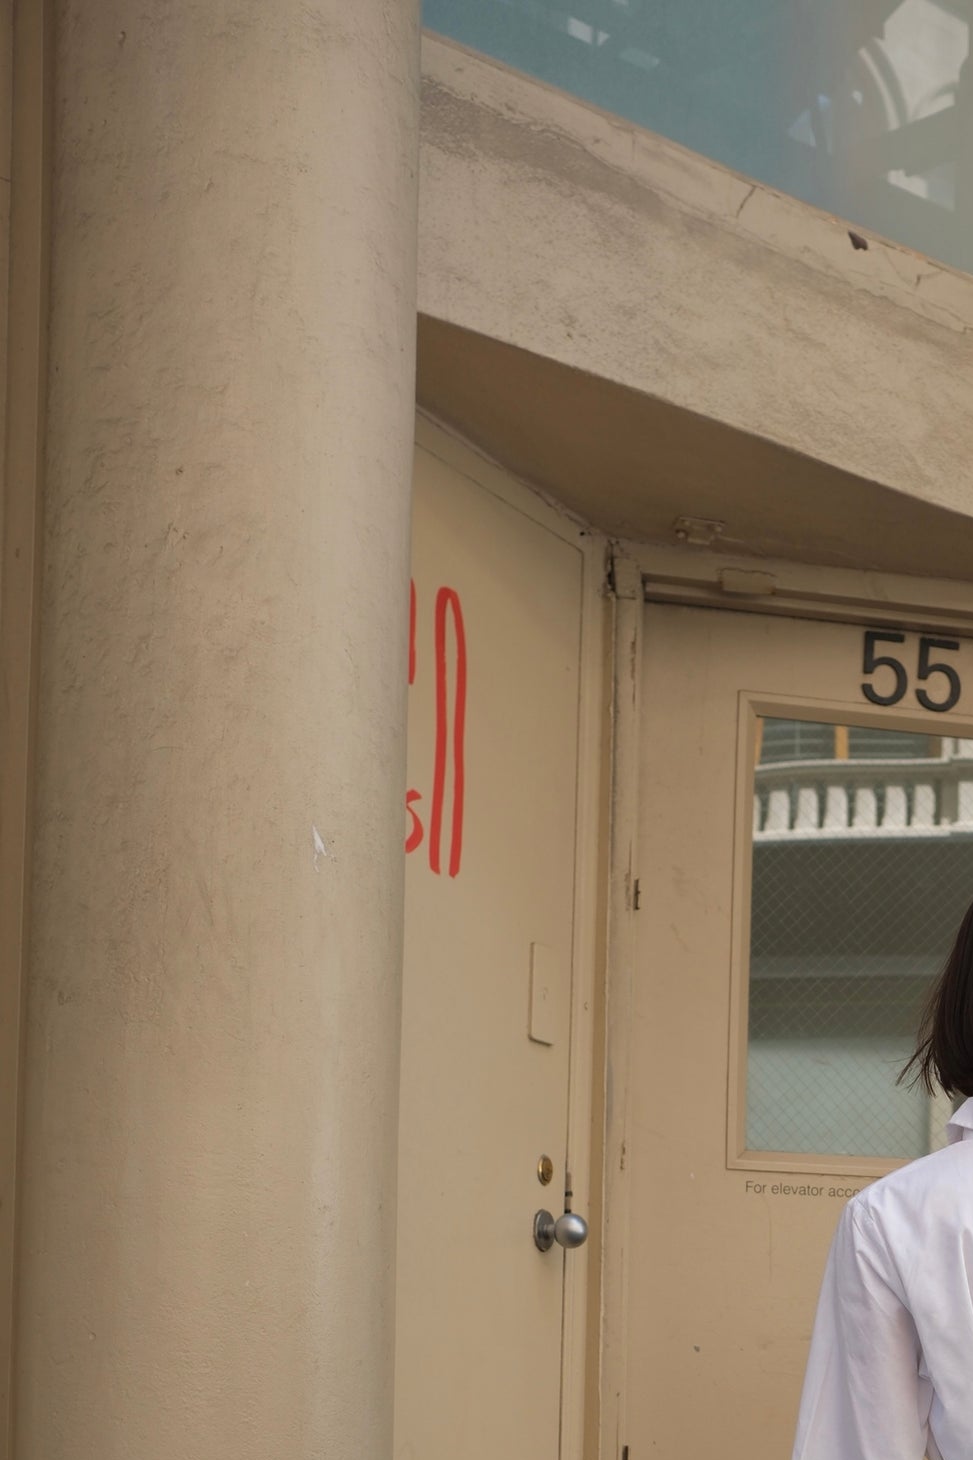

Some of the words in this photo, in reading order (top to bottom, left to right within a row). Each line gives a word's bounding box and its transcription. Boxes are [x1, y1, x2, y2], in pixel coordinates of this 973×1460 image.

[861, 631, 961, 713] 55
[745, 1180, 766, 1194] For
[771, 1182, 824, 1196] elevator
